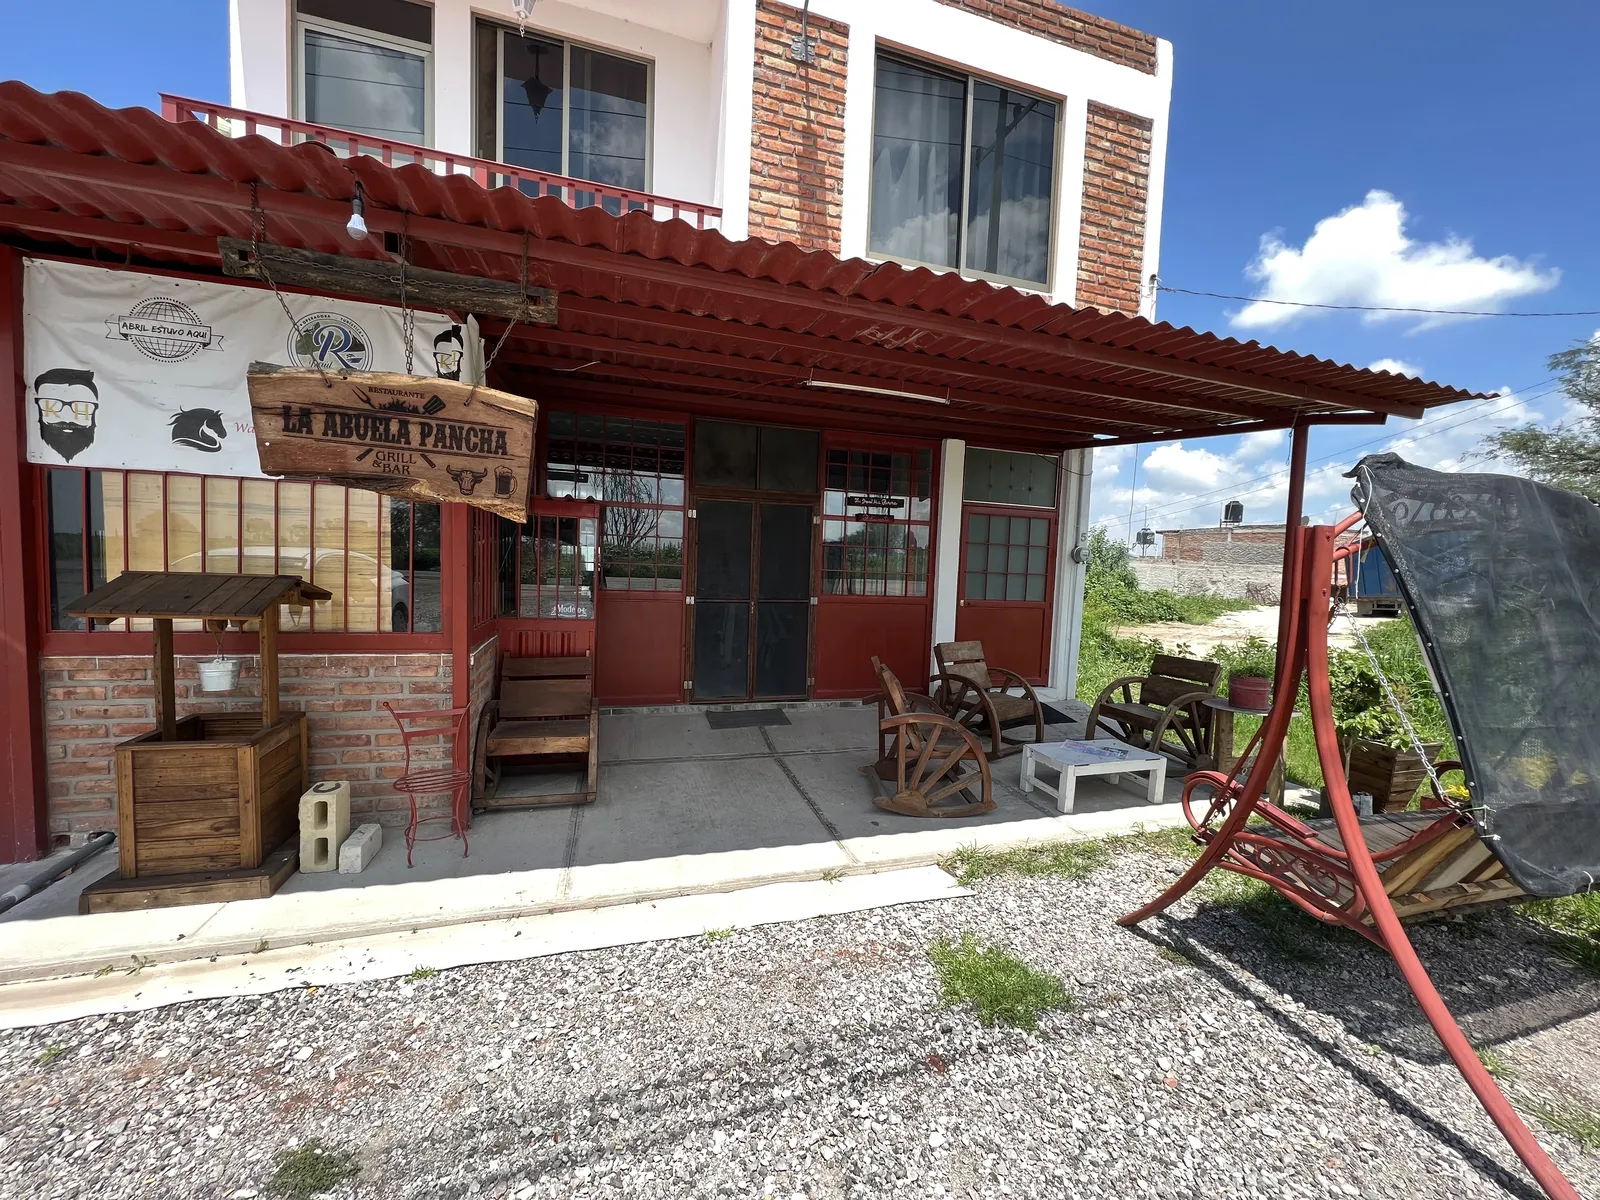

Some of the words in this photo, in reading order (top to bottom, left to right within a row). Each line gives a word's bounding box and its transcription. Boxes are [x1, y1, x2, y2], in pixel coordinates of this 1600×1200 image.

[302, 314, 331, 324] OPERADORA
[121, 321, 149, 332] ABRIL
[151, 325, 184, 336] ESTUVO
[368, 386, 425, 400] RESTAURANTE
[282, 405, 314, 435] LA
[322, 410, 412, 446] ABUELA
[418, 421, 509, 456] PANCHA
[375, 450, 417, 465] GRILL
[1080, 532, 1087, 542] 5
[557, 603, 582, 614] Modeo
